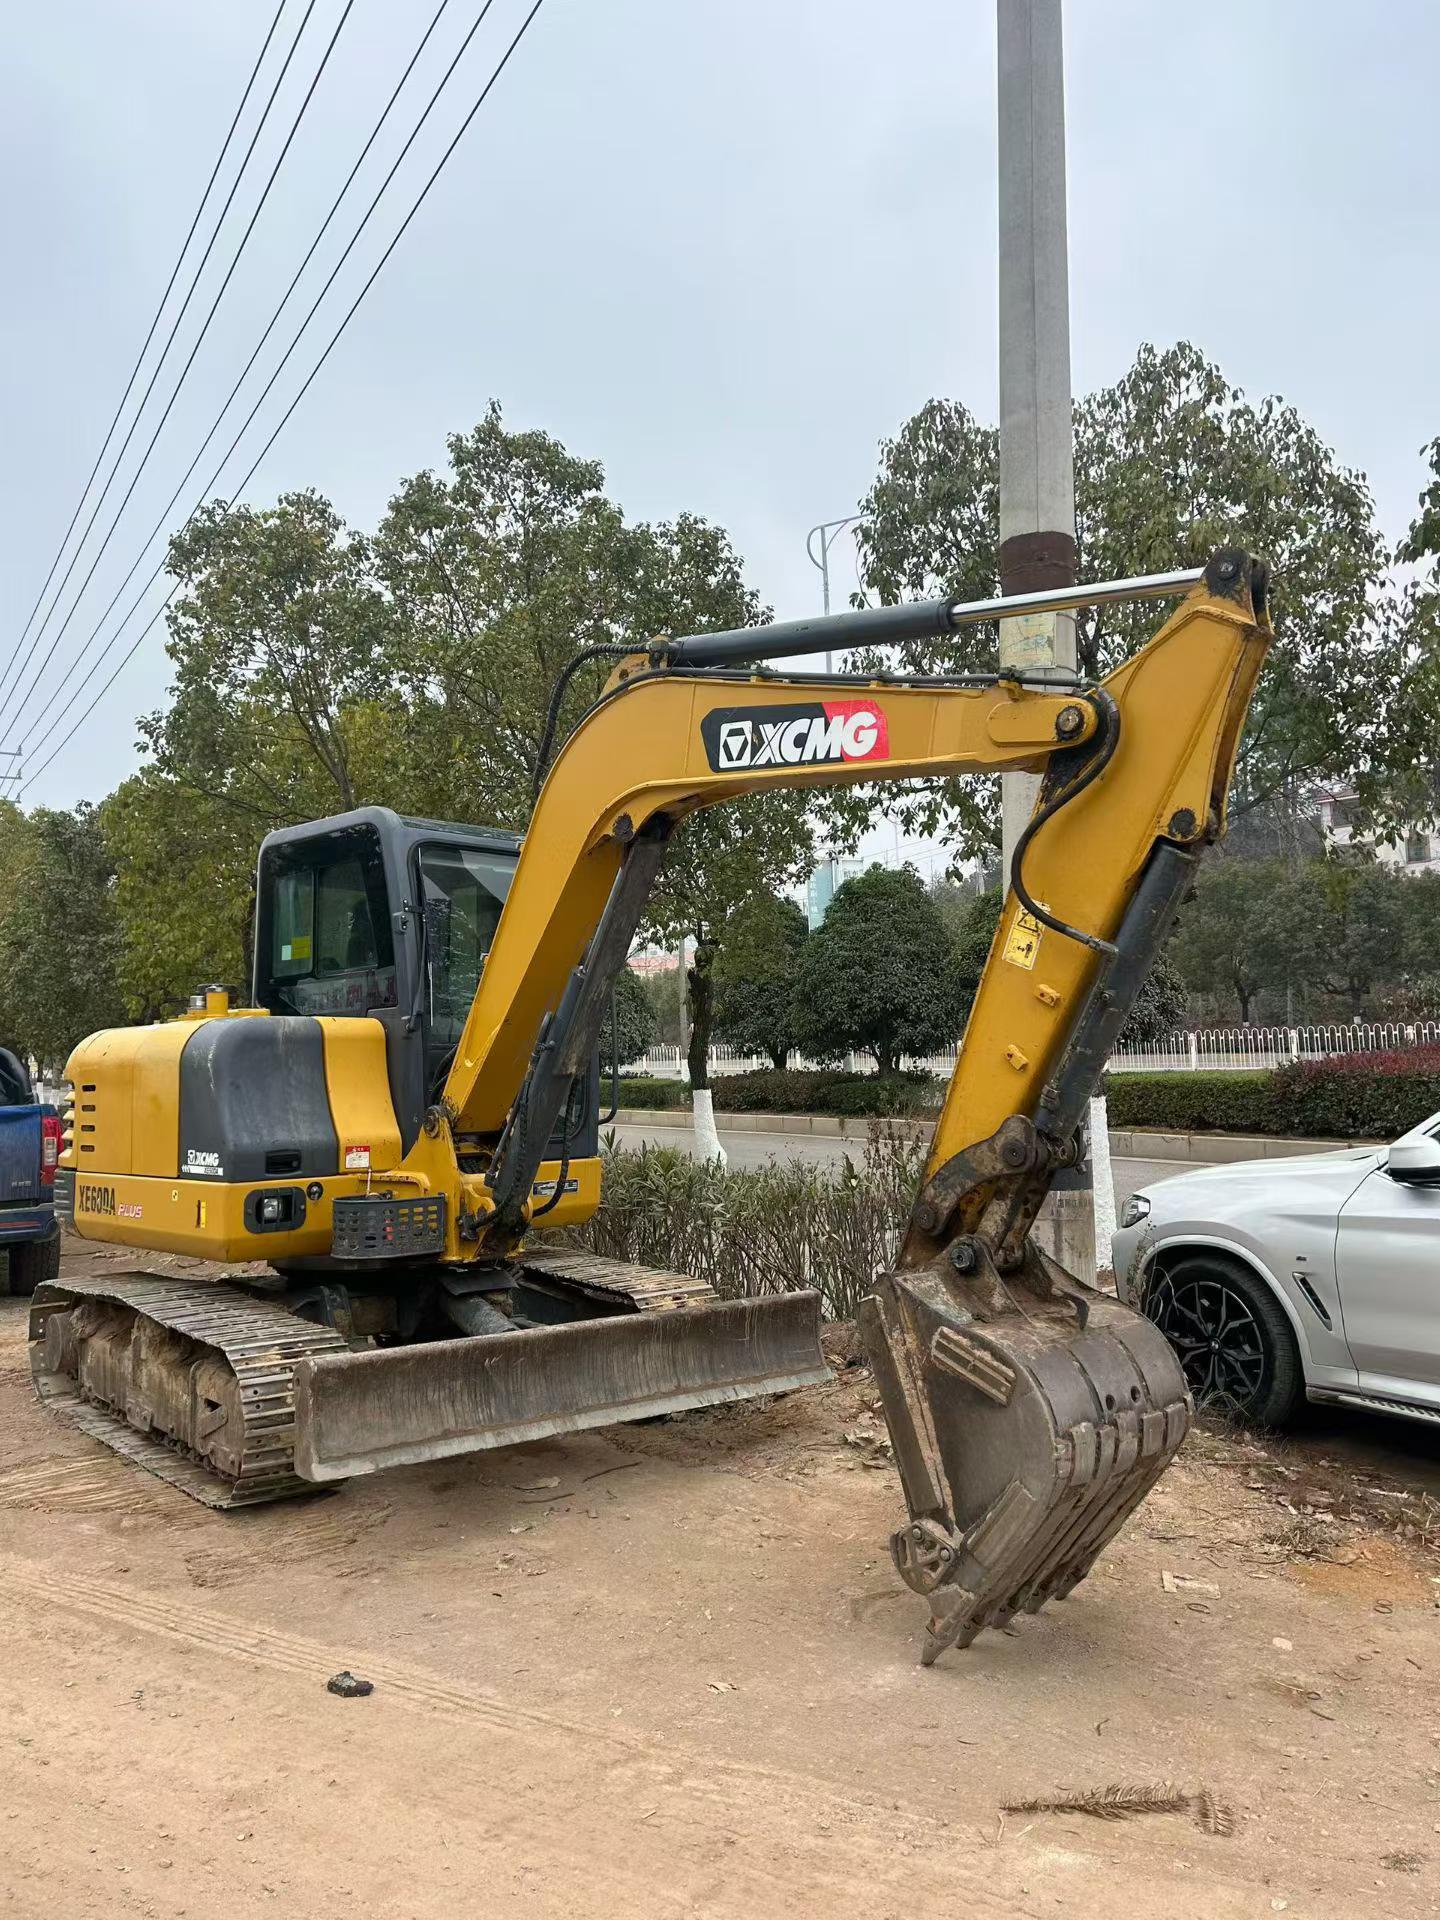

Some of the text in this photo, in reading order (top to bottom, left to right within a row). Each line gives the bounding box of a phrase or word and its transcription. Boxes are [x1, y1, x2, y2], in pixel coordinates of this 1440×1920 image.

[750, 711, 878, 765] XCMG
[195, 1151, 219, 1167] XCMG
[117, 1203, 143, 1218] PLUS
